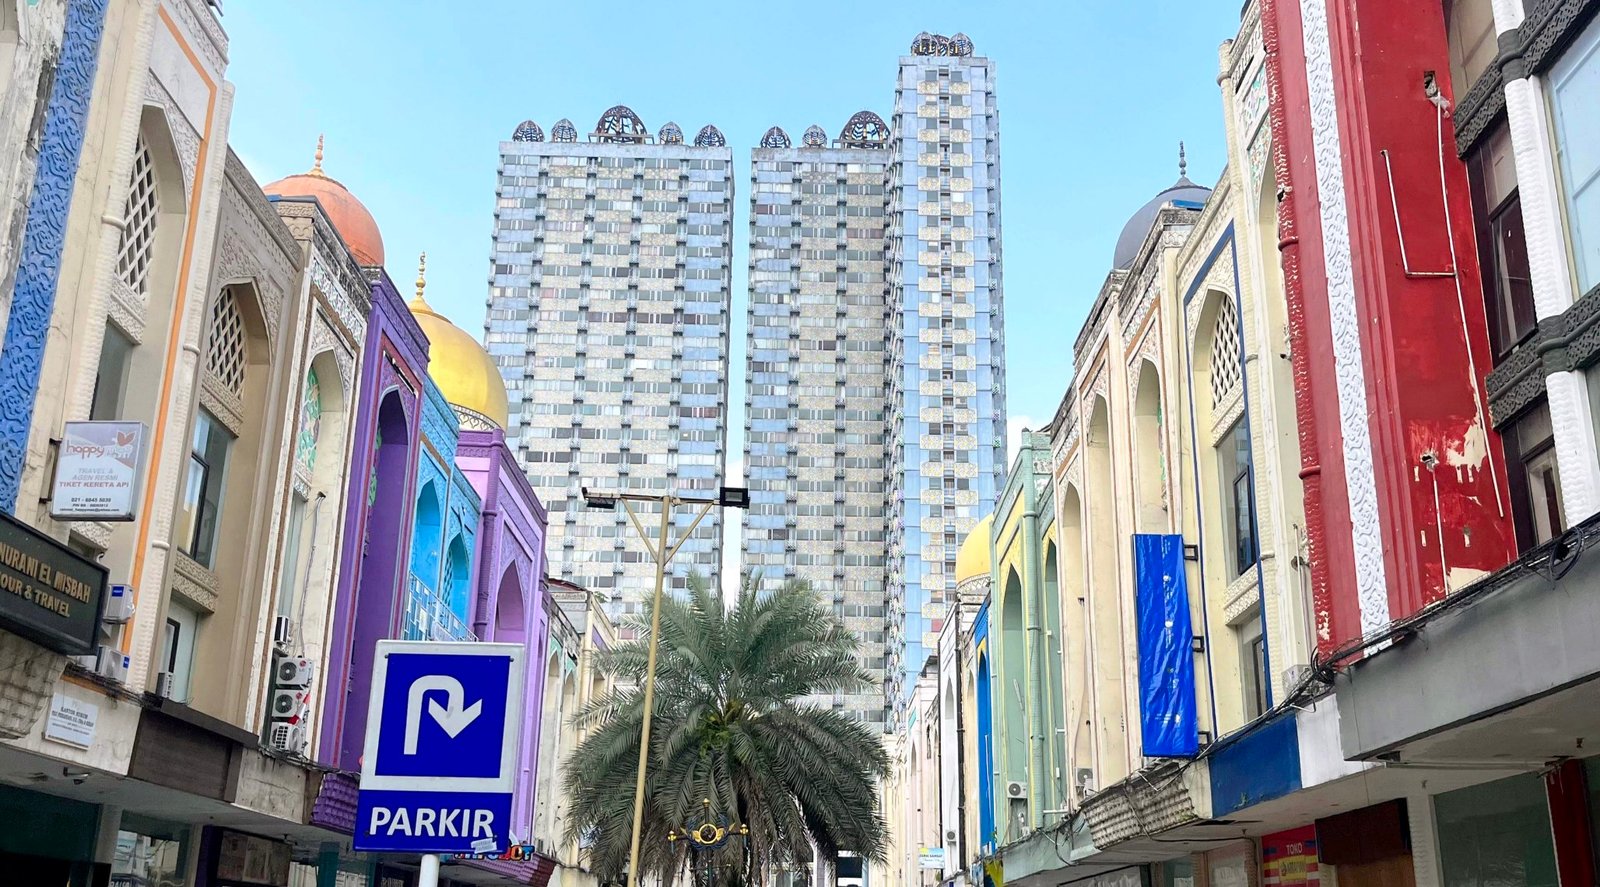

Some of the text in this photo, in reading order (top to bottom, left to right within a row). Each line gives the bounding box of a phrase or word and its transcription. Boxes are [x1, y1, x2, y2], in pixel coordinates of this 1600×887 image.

[66, 440, 105, 460] happy
[0, 571, 70, 618] OUR & TRAVEL
[38, 563, 52, 586] EL
[53, 570, 91, 604] MISBAH
[369, 806, 495, 838] PARKIR
[1286, 842, 1303, 855] TOKO
